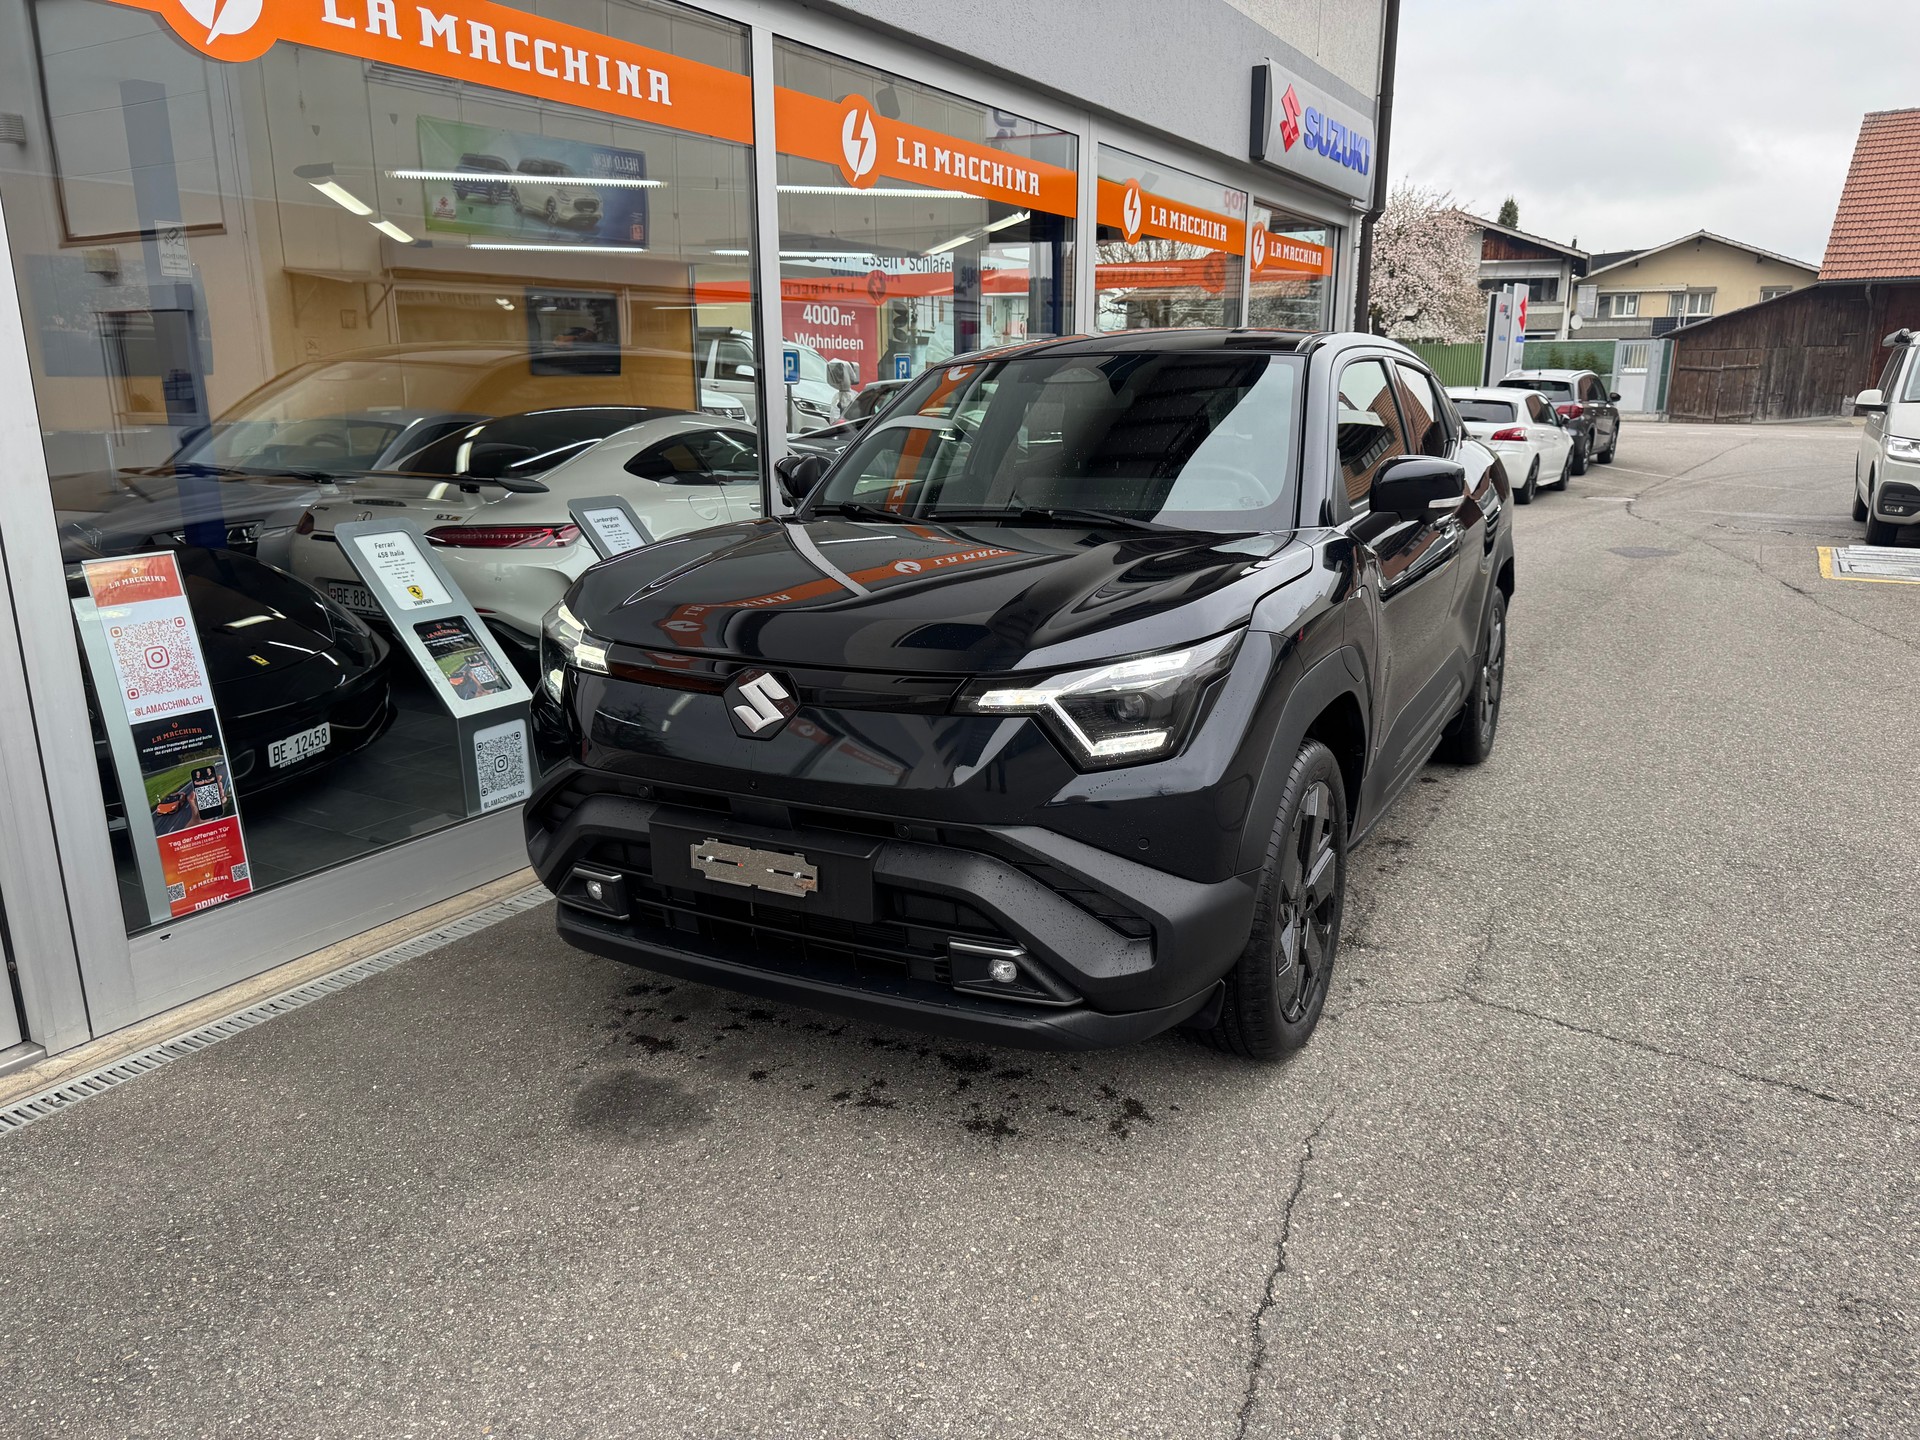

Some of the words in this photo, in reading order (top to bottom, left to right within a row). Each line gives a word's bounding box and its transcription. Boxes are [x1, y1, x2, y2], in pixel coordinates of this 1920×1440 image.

[321, 0, 402, 40] LA
[416, 5, 672, 106] MACCHINA
[1303, 106, 1370, 176] SUZUKI
[896, 136, 928, 169] LA
[933, 146, 1040, 196] MACCHINA
[1150, 205, 1168, 226] LA
[1169, 210, 1227, 242] MACCHINA
[1270, 241, 1282, 257] LA
[1282, 244, 1322, 267] MACCHINA
[802, 304, 839, 326] 4000
[794, 332, 864, 350] Wohnideen
[785, 359, 795, 377] P
[374, 541, 396, 549] Ferrari
[122, 575, 167, 586] MACCHINA
[134, 695, 204, 717] @LAMACCHINA.CH
[152, 735, 162, 744] LA
[163, 727, 203, 740] MACCHINA
[483, 789, 525, 809] @LAMACCHINA.CH
[182, 836, 193, 844] der
[193, 830, 218, 840] offenen
[198, 875, 229, 887] MACCHINA
